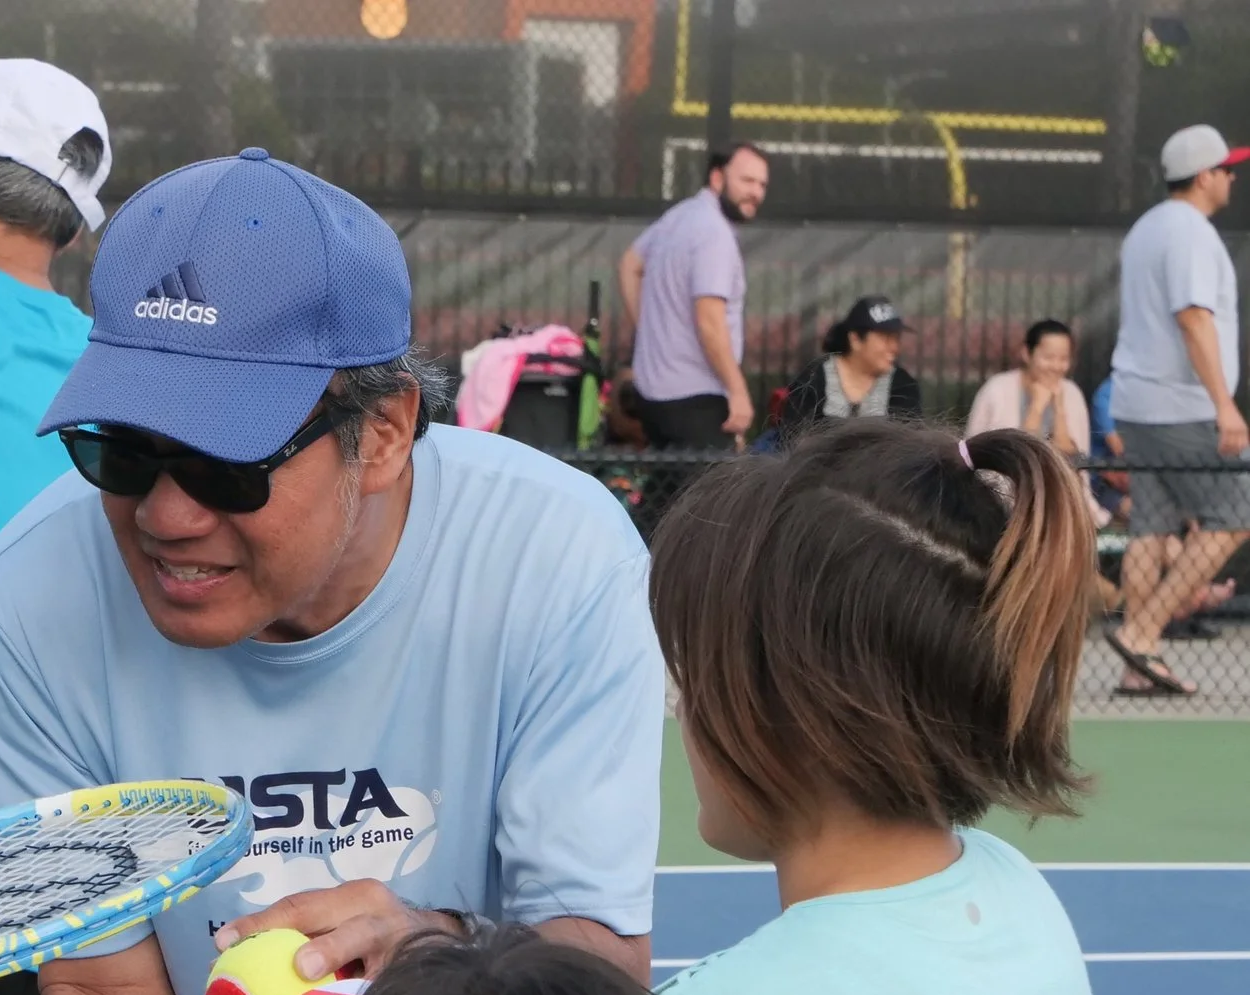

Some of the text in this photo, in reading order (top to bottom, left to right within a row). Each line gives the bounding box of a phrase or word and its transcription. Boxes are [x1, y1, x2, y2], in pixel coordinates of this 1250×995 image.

[134, 297, 218, 325] adidas
[244, 836, 304, 857] urself
[309, 836, 323, 854] in
[328, 834, 355, 852] the
[361, 827, 414, 848] game
